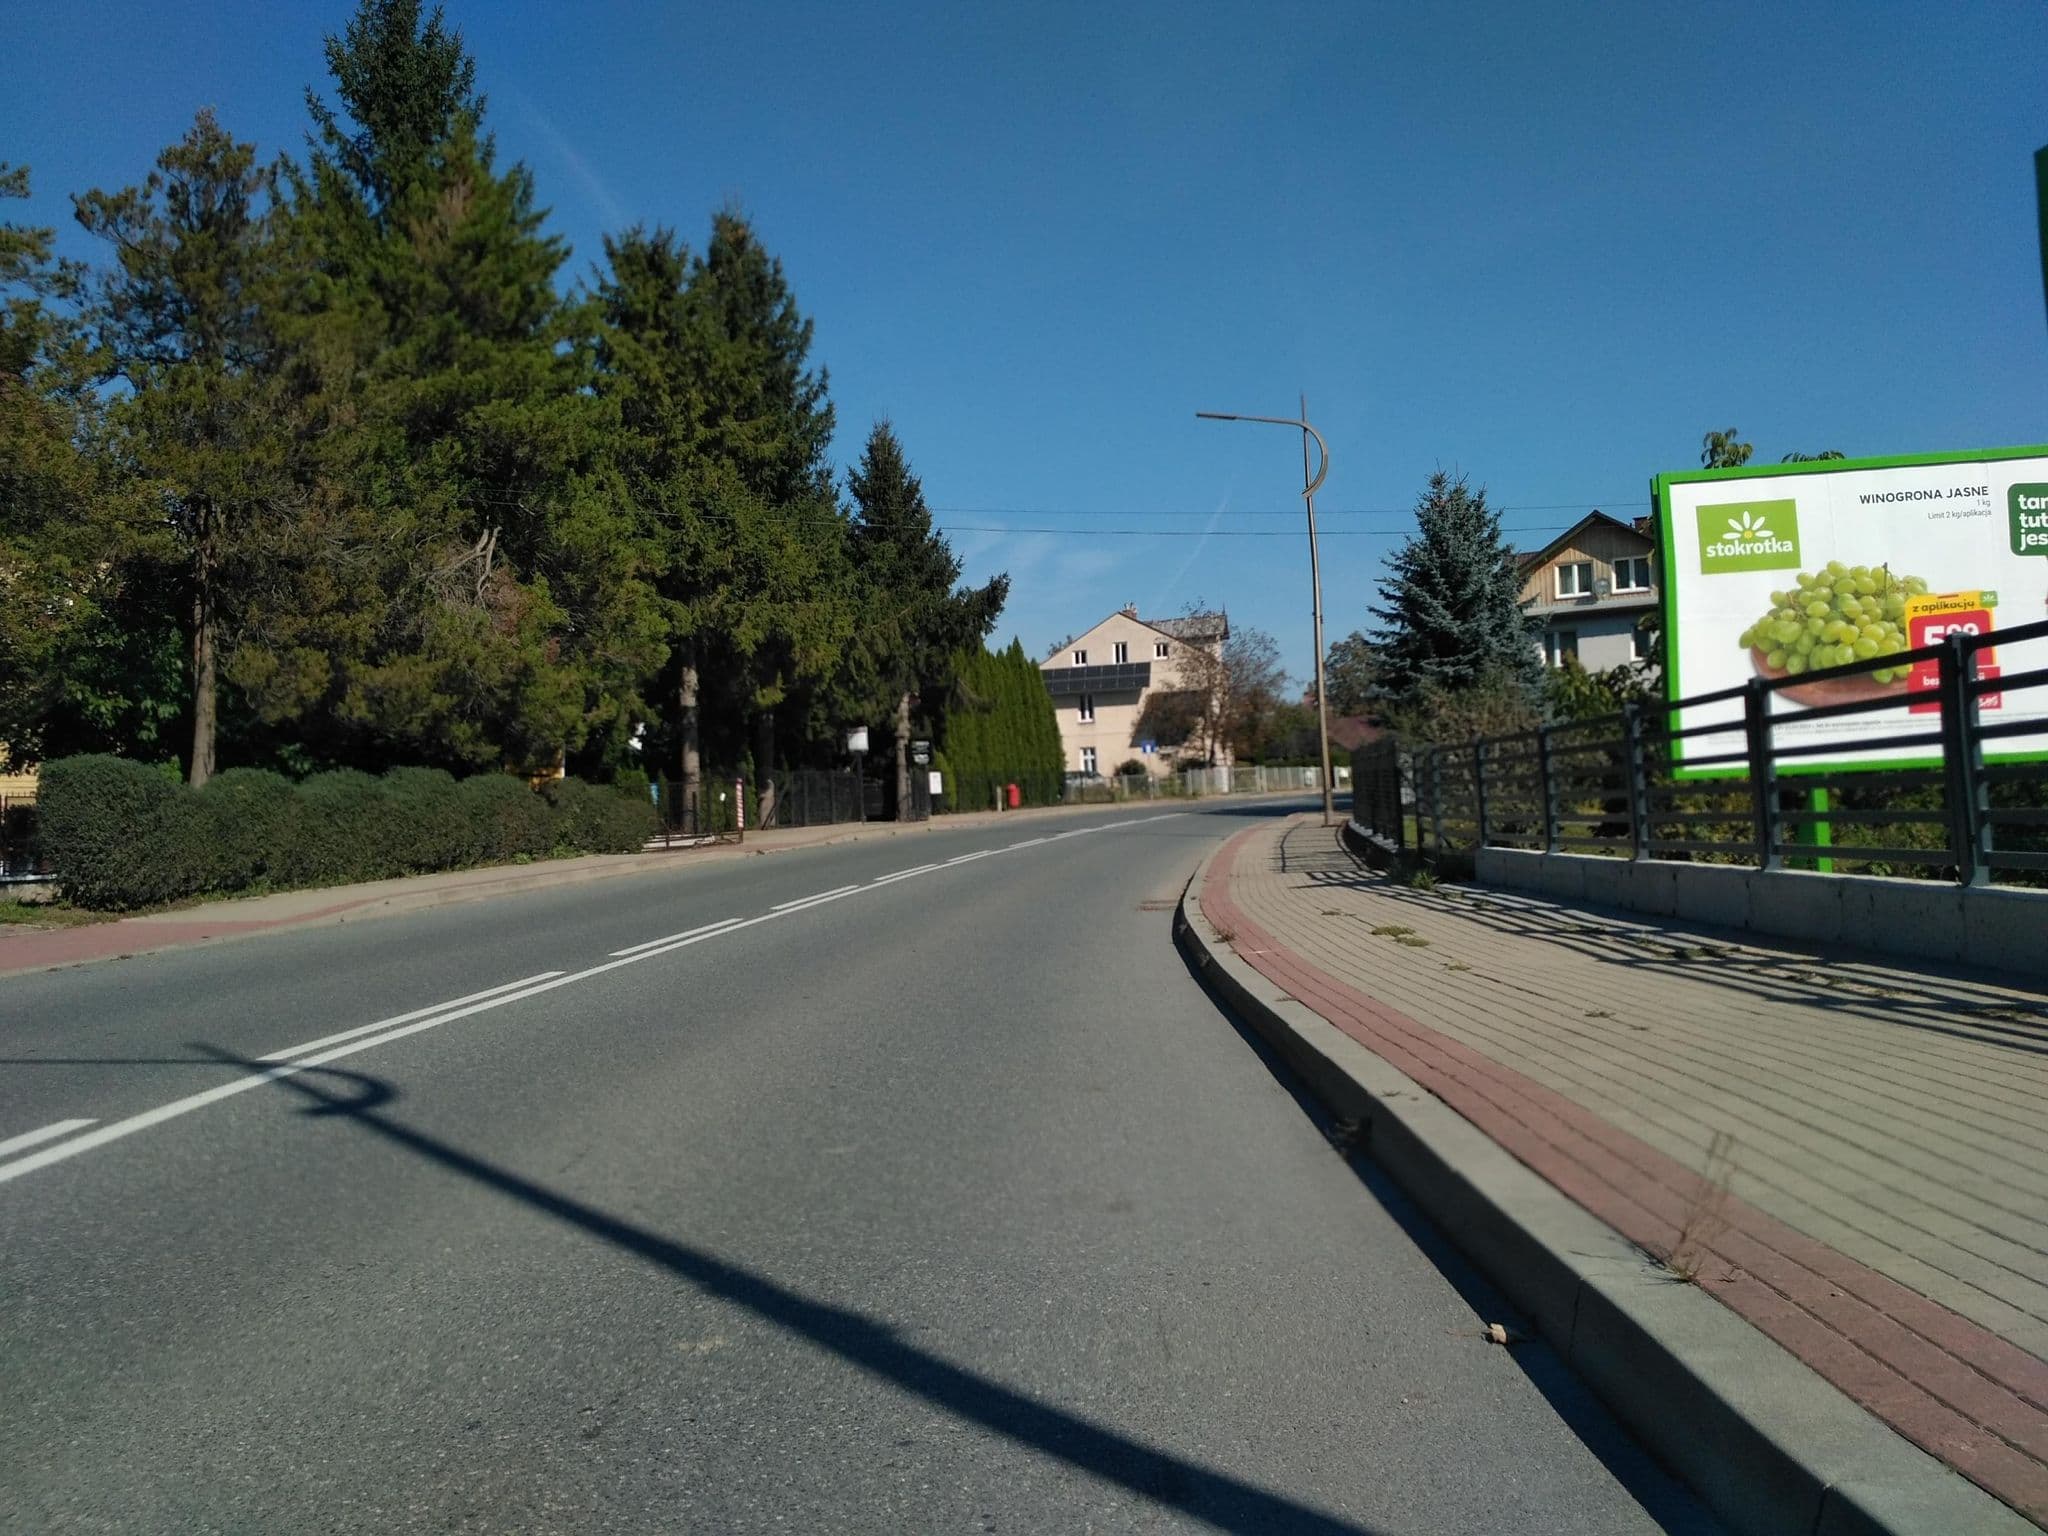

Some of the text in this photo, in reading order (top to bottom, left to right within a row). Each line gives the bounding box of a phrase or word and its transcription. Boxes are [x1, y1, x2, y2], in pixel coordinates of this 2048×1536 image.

[1859, 486, 1989, 505] WINOGRONA JASNE
[1982, 499, 1991, 508] kg
[1927, 512, 1945, 520] Limit
[1706, 536, 1793, 558] stokrotka
